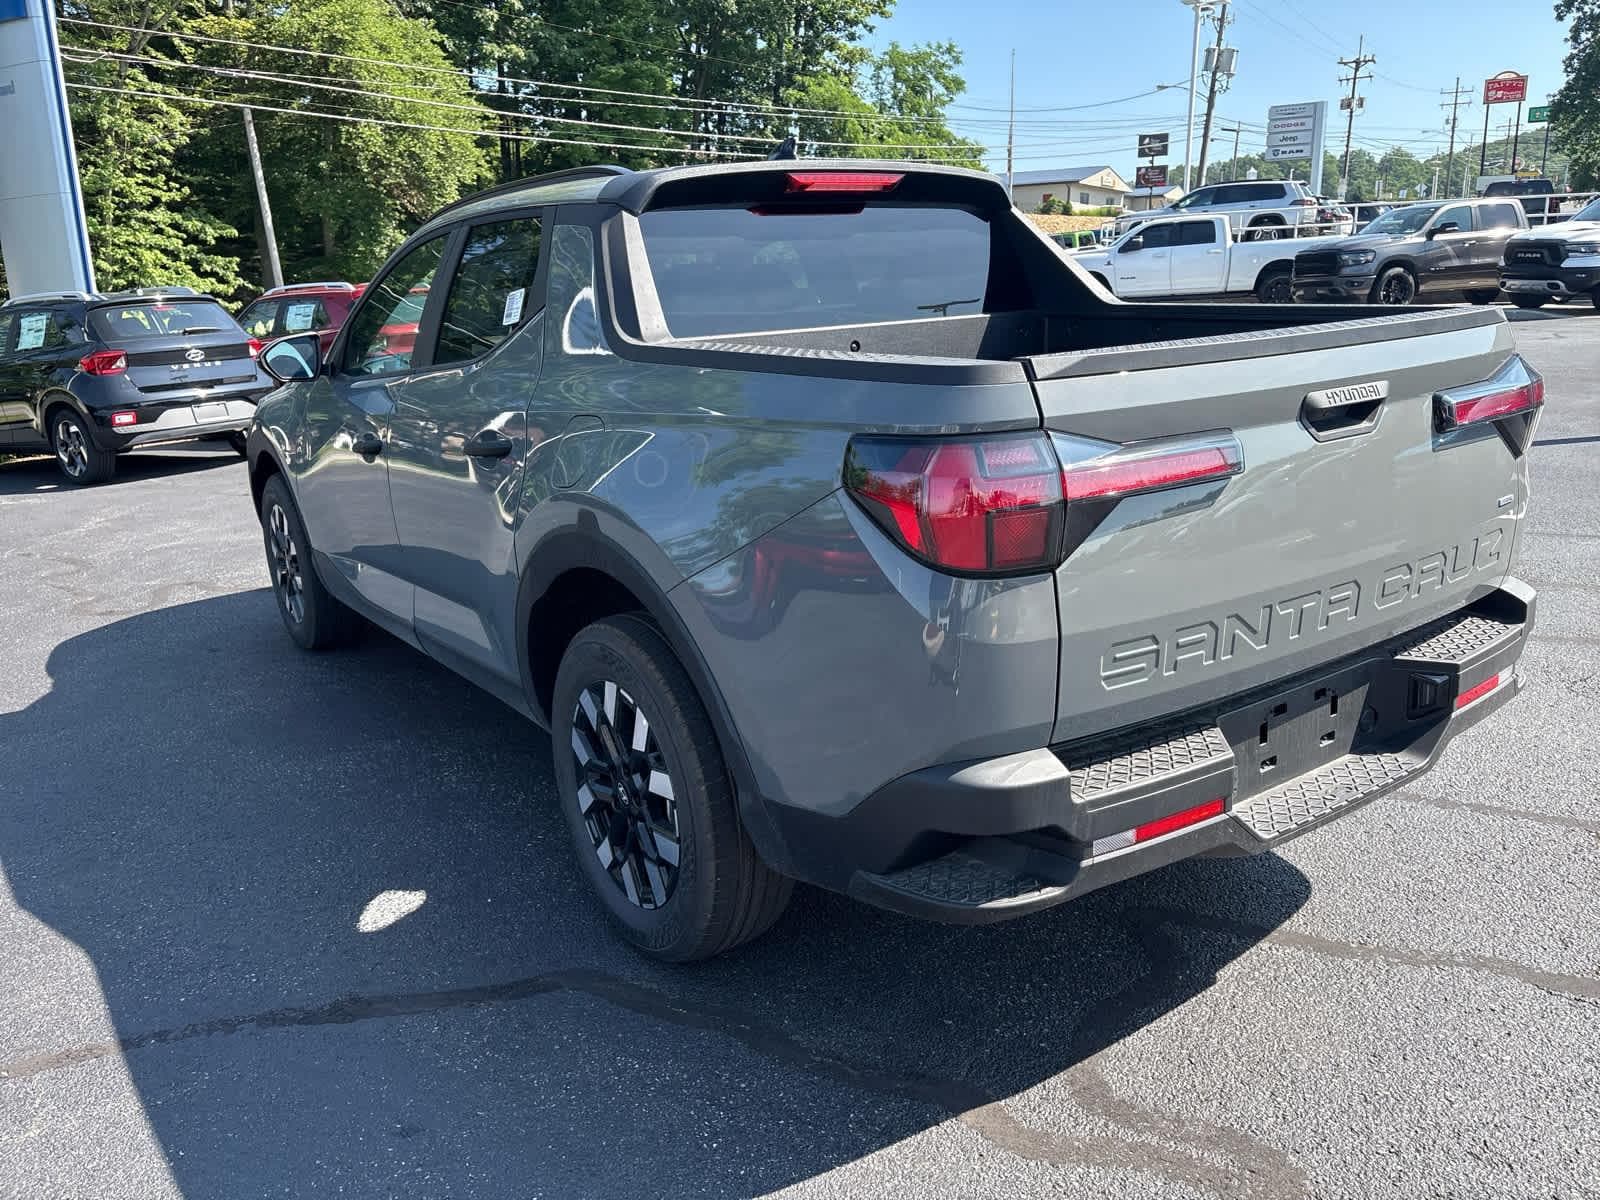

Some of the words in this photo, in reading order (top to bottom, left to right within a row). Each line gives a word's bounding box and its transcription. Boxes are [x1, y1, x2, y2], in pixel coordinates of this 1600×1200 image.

[1273, 121, 1306, 129] DODGE
[171, 360, 222, 370] VENUE
[1325, 384, 1381, 406] HYUNDAI
[1100, 579, 1362, 691] SANTA
[1374, 527, 1505, 612] CRUZ
